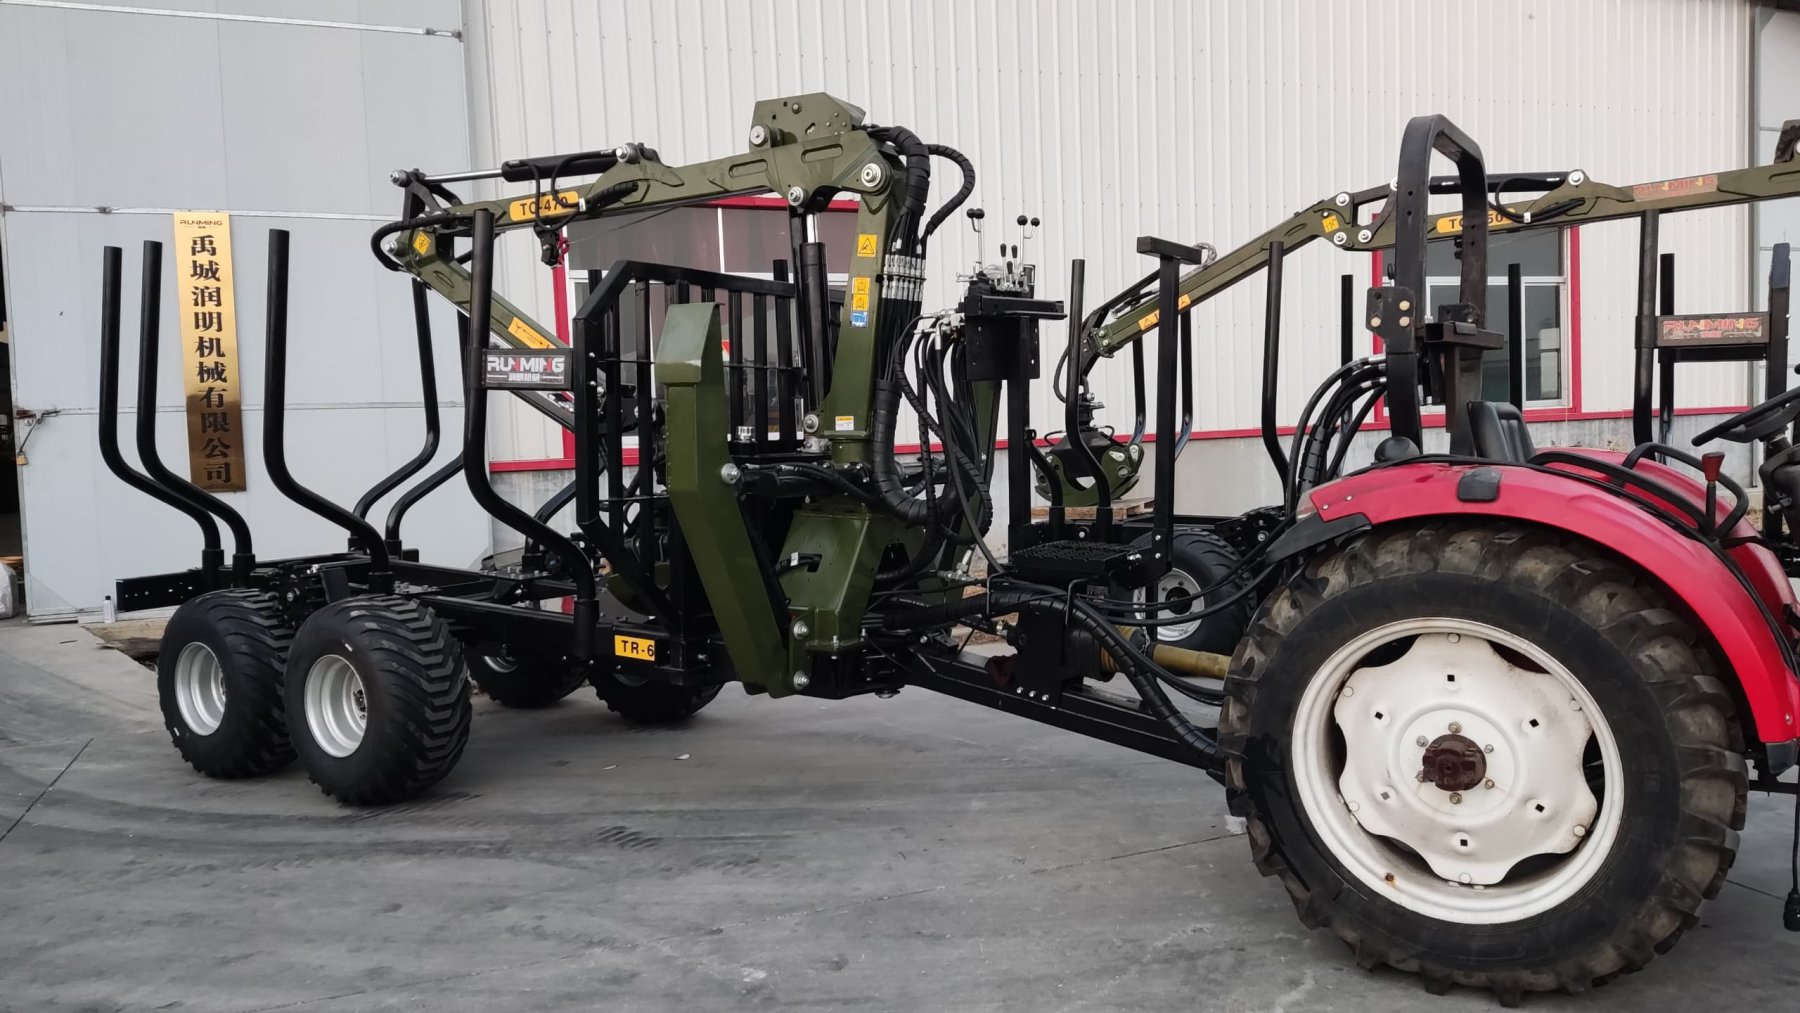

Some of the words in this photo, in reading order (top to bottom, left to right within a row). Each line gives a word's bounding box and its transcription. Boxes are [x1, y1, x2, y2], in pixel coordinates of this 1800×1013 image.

[190, 234, 231, 484] 禹城润明机械有限公司
[487, 356, 565, 373] RUNMING
[621, 639, 654, 657] TR-6
